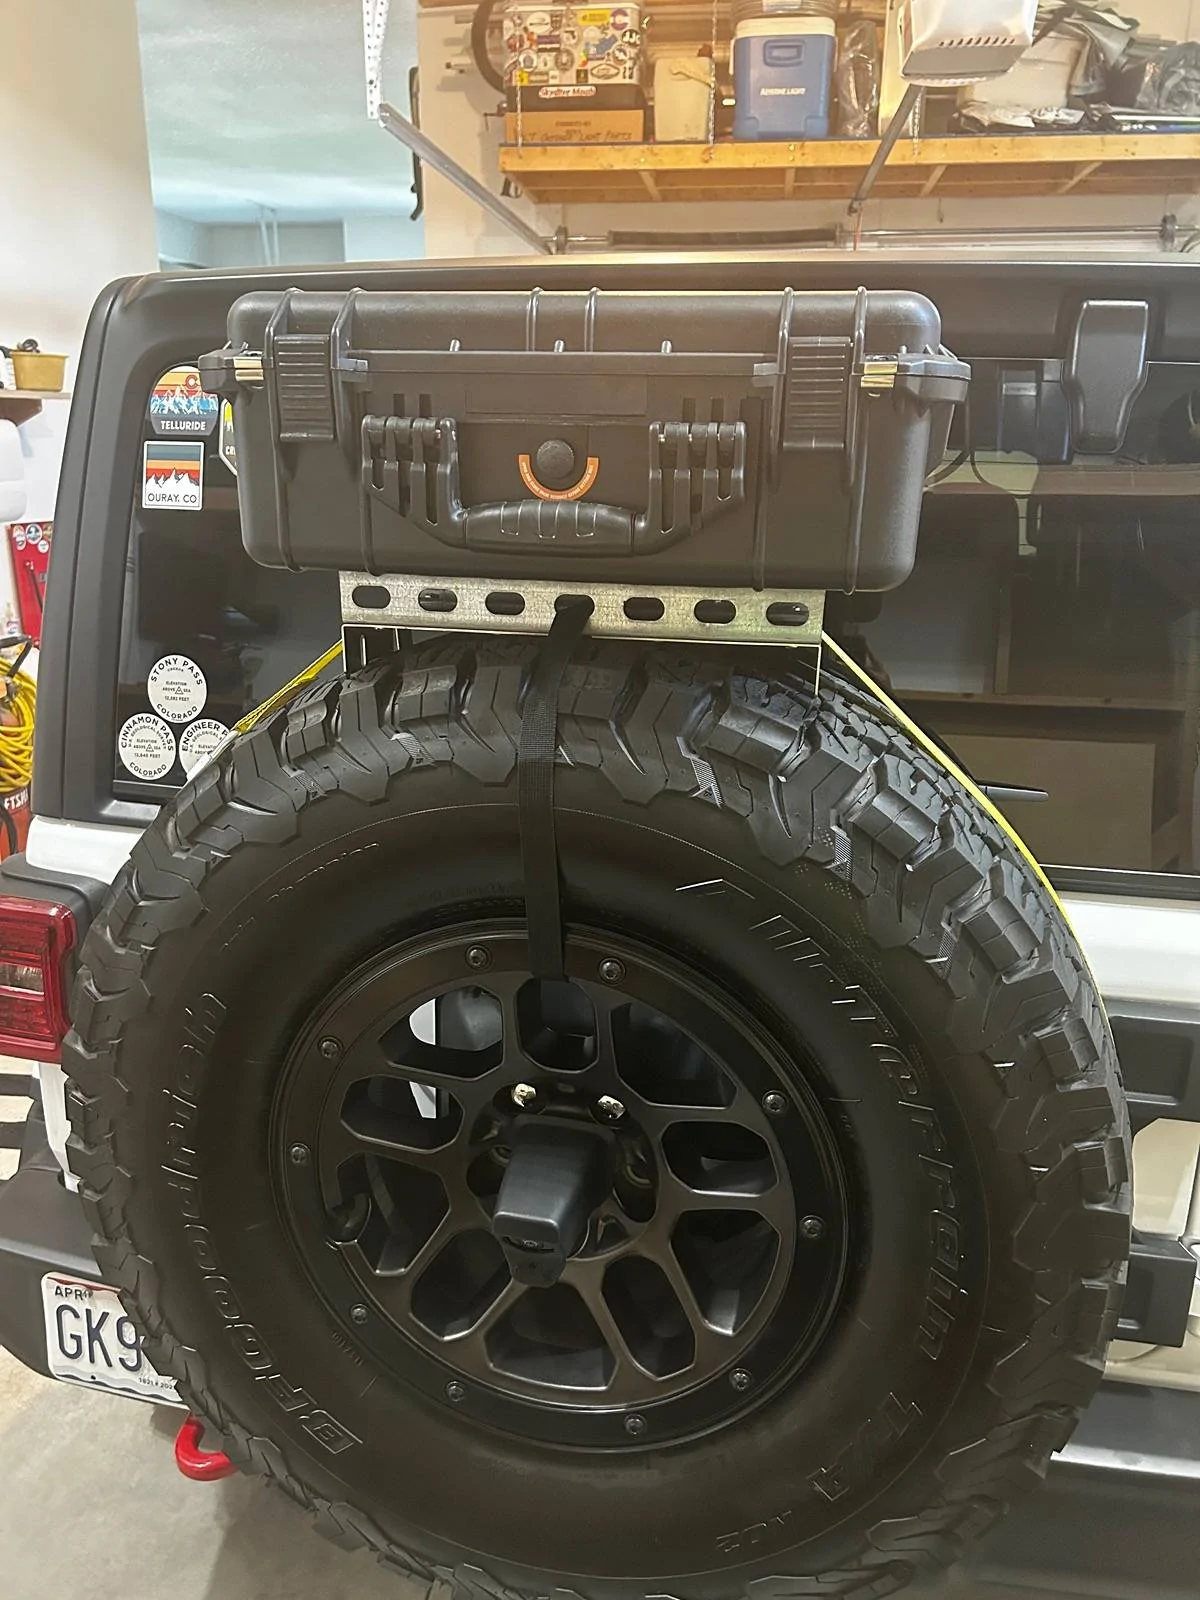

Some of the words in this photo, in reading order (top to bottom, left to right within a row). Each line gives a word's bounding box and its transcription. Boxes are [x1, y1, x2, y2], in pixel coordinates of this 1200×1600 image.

[160, 420, 206, 431] TELLURIDE
[183, 494, 197, 503] CO
[150, 657, 178, 682] STONY
[182, 660, 203, 685] PASS
[156, 703, 198, 719] COLORADO
[120, 716, 159, 748] CINNAMON
[160, 725, 174, 751] PASS
[181, 721, 221, 752] ENGINEER
[129, 761, 167, 776] COLORADO
[55, 1285, 83, 1301] APR
[56, 1303, 142, 1372] GK9
